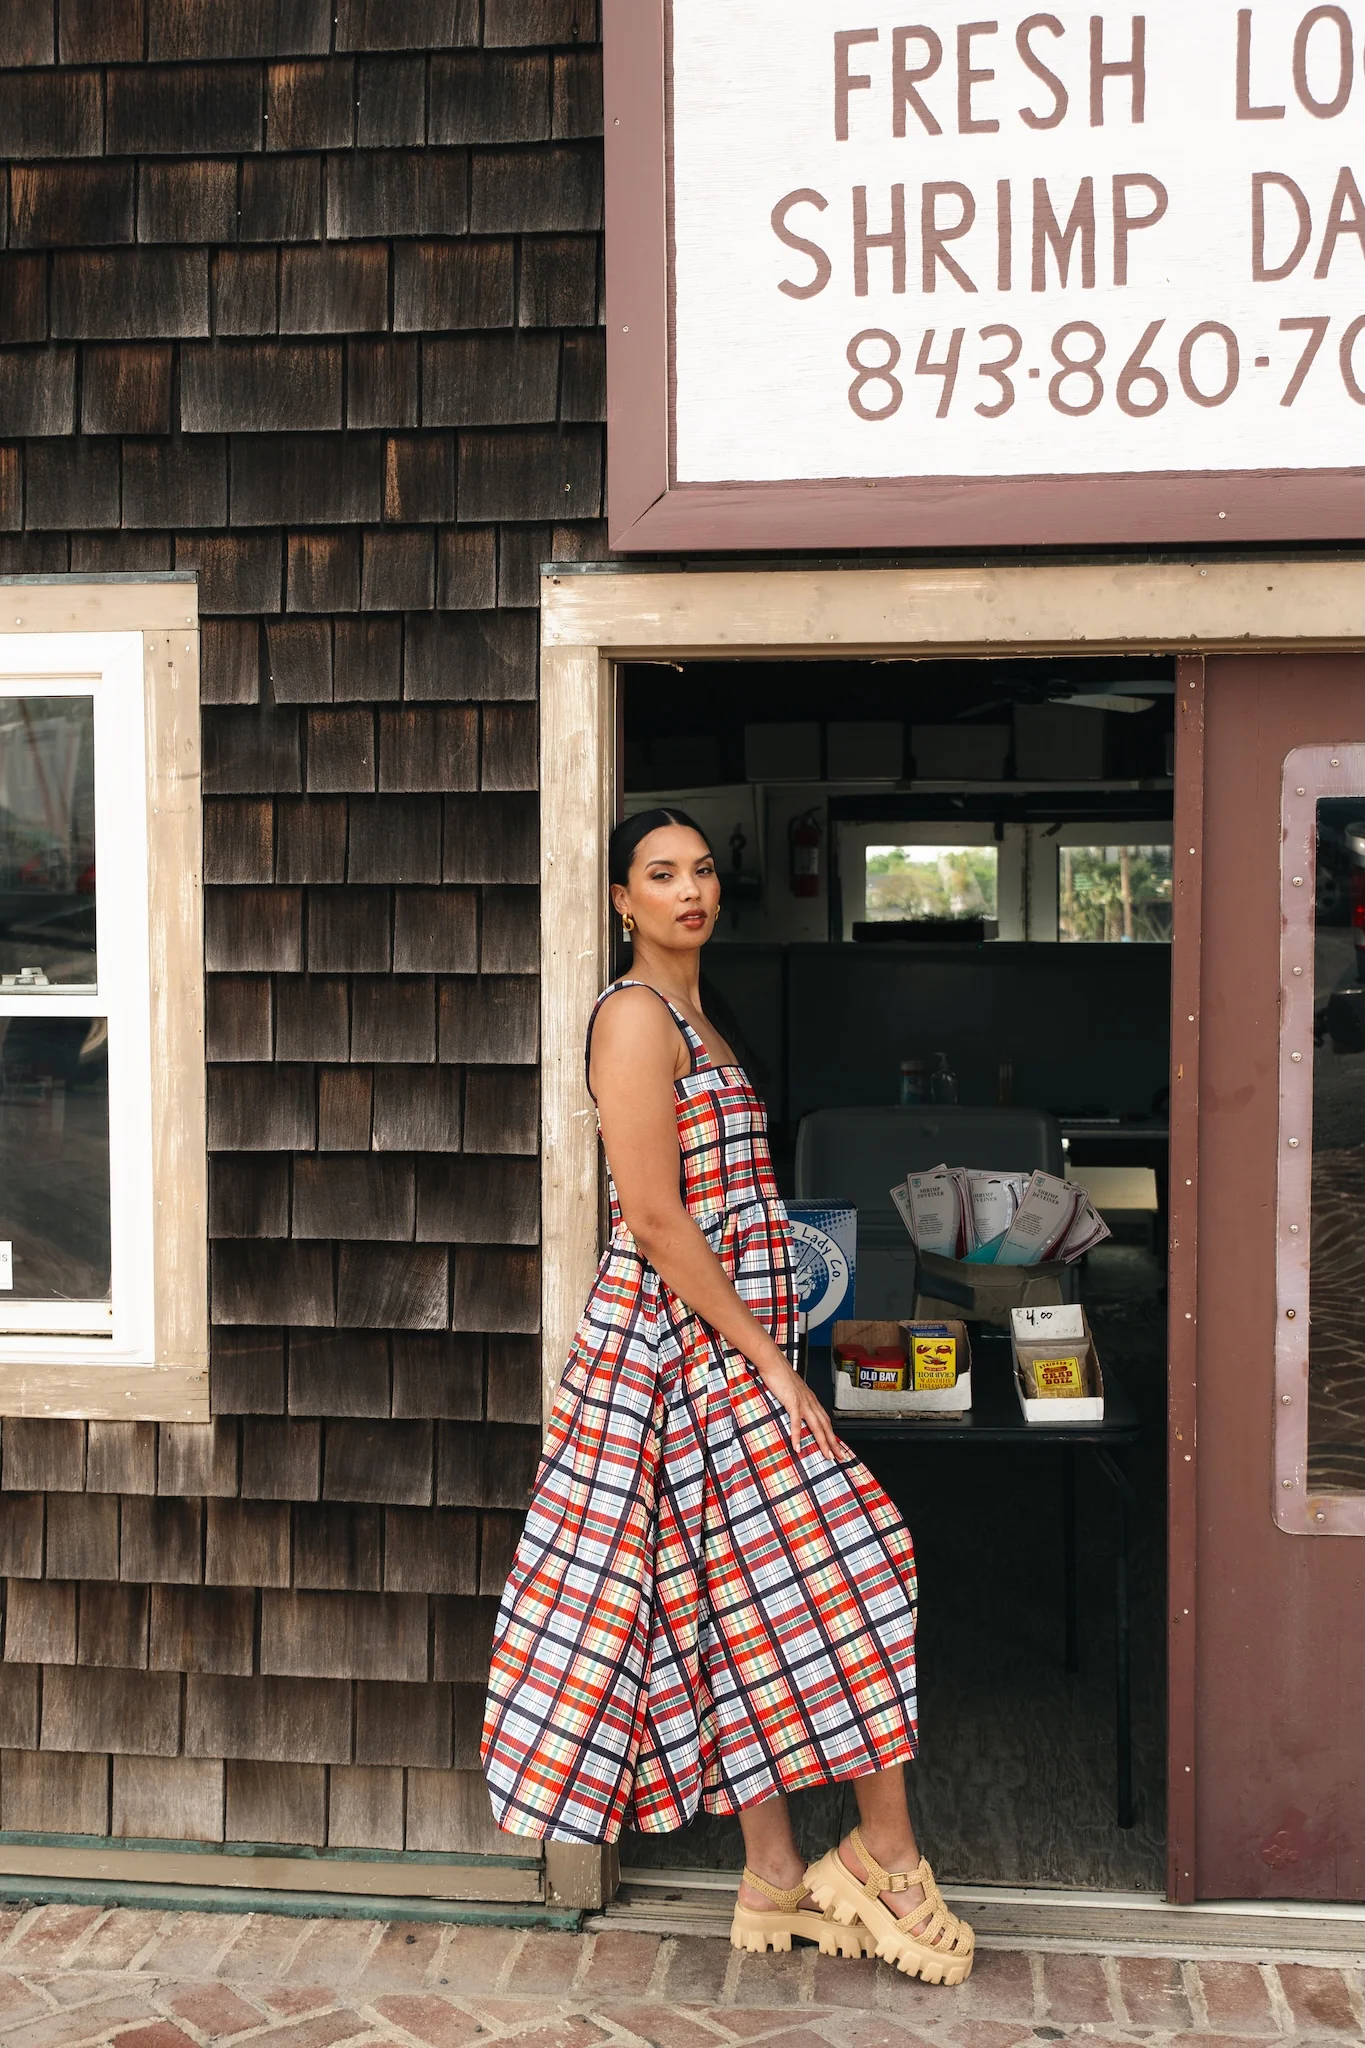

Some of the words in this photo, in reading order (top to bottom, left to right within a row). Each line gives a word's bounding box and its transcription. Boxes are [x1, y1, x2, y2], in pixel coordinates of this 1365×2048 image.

[833, 13, 1146, 142] FRESH
[1235, 4, 1365, 121] LO
[770, 173, 1169, 300] SHRIMP
[802, 1227, 832, 1256] Lady
[830, 1259, 842, 1282] Co.
[860, 1370, 878, 1381] OLD
[879, 1372, 897, 1382] BAY
[935, 1371, 955, 1379] CRAB
[1042, 1371, 1073, 1380] CRAB
